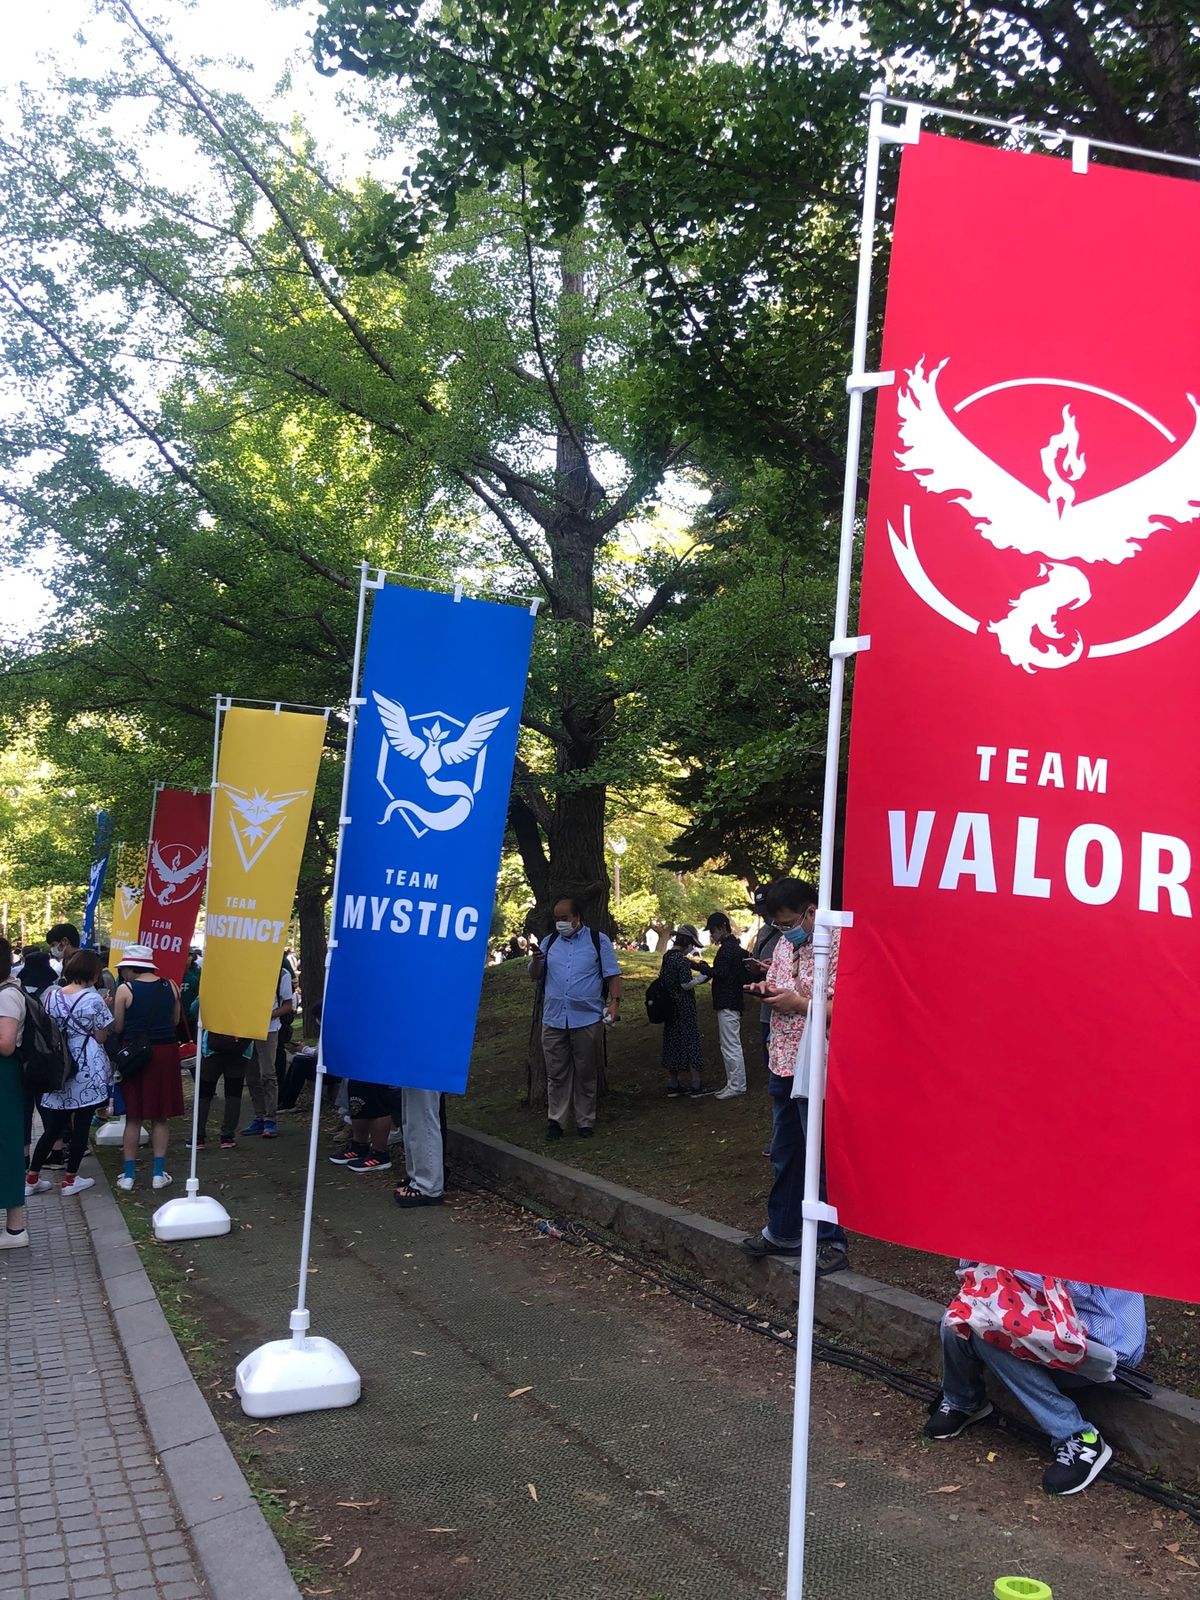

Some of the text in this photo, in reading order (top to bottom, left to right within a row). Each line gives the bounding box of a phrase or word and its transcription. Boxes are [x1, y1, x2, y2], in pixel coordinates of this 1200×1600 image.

[976, 745, 1108, 793] TEAM
[887, 810, 1192, 918] VALOR
[385, 868, 439, 890] TEAM
[225, 896, 256, 910] TEAM
[151, 919, 172, 930] TEAM
[342, 894, 479, 942] MYSTIC
[140, 930, 183, 953] VALOR
